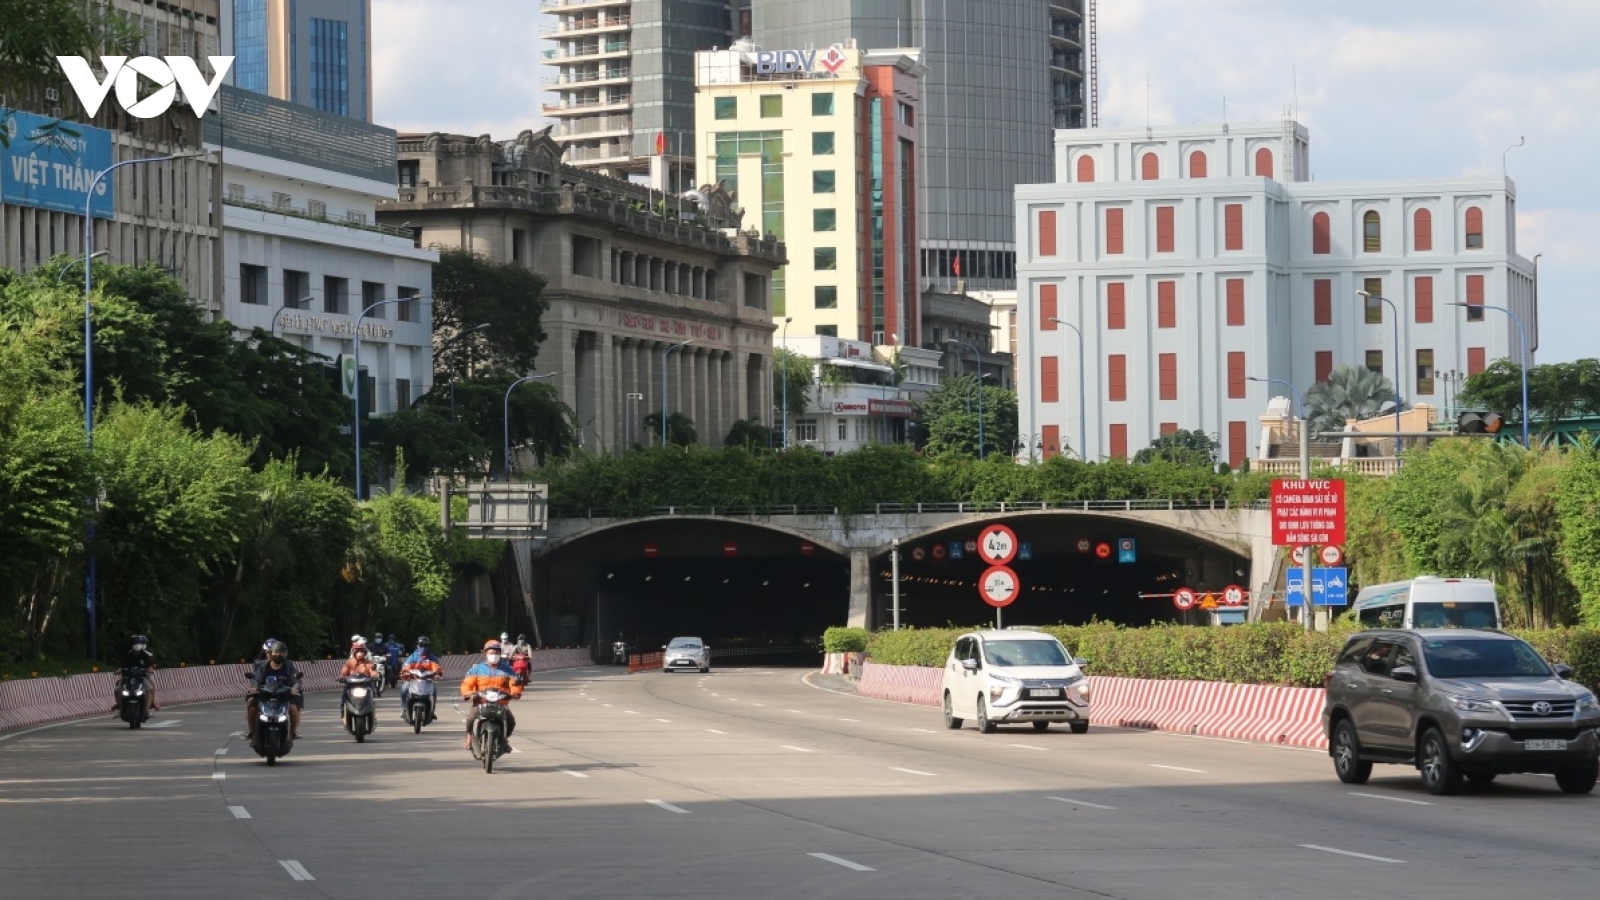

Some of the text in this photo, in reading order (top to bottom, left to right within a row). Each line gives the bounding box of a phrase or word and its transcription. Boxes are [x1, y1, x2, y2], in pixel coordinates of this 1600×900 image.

[757, 50, 816, 74] BIDV
[79, 139, 87, 153] TY
[12, 152, 106, 196] VIỆT THẮNG
[1282, 481, 1330, 491] KHU VỰC
